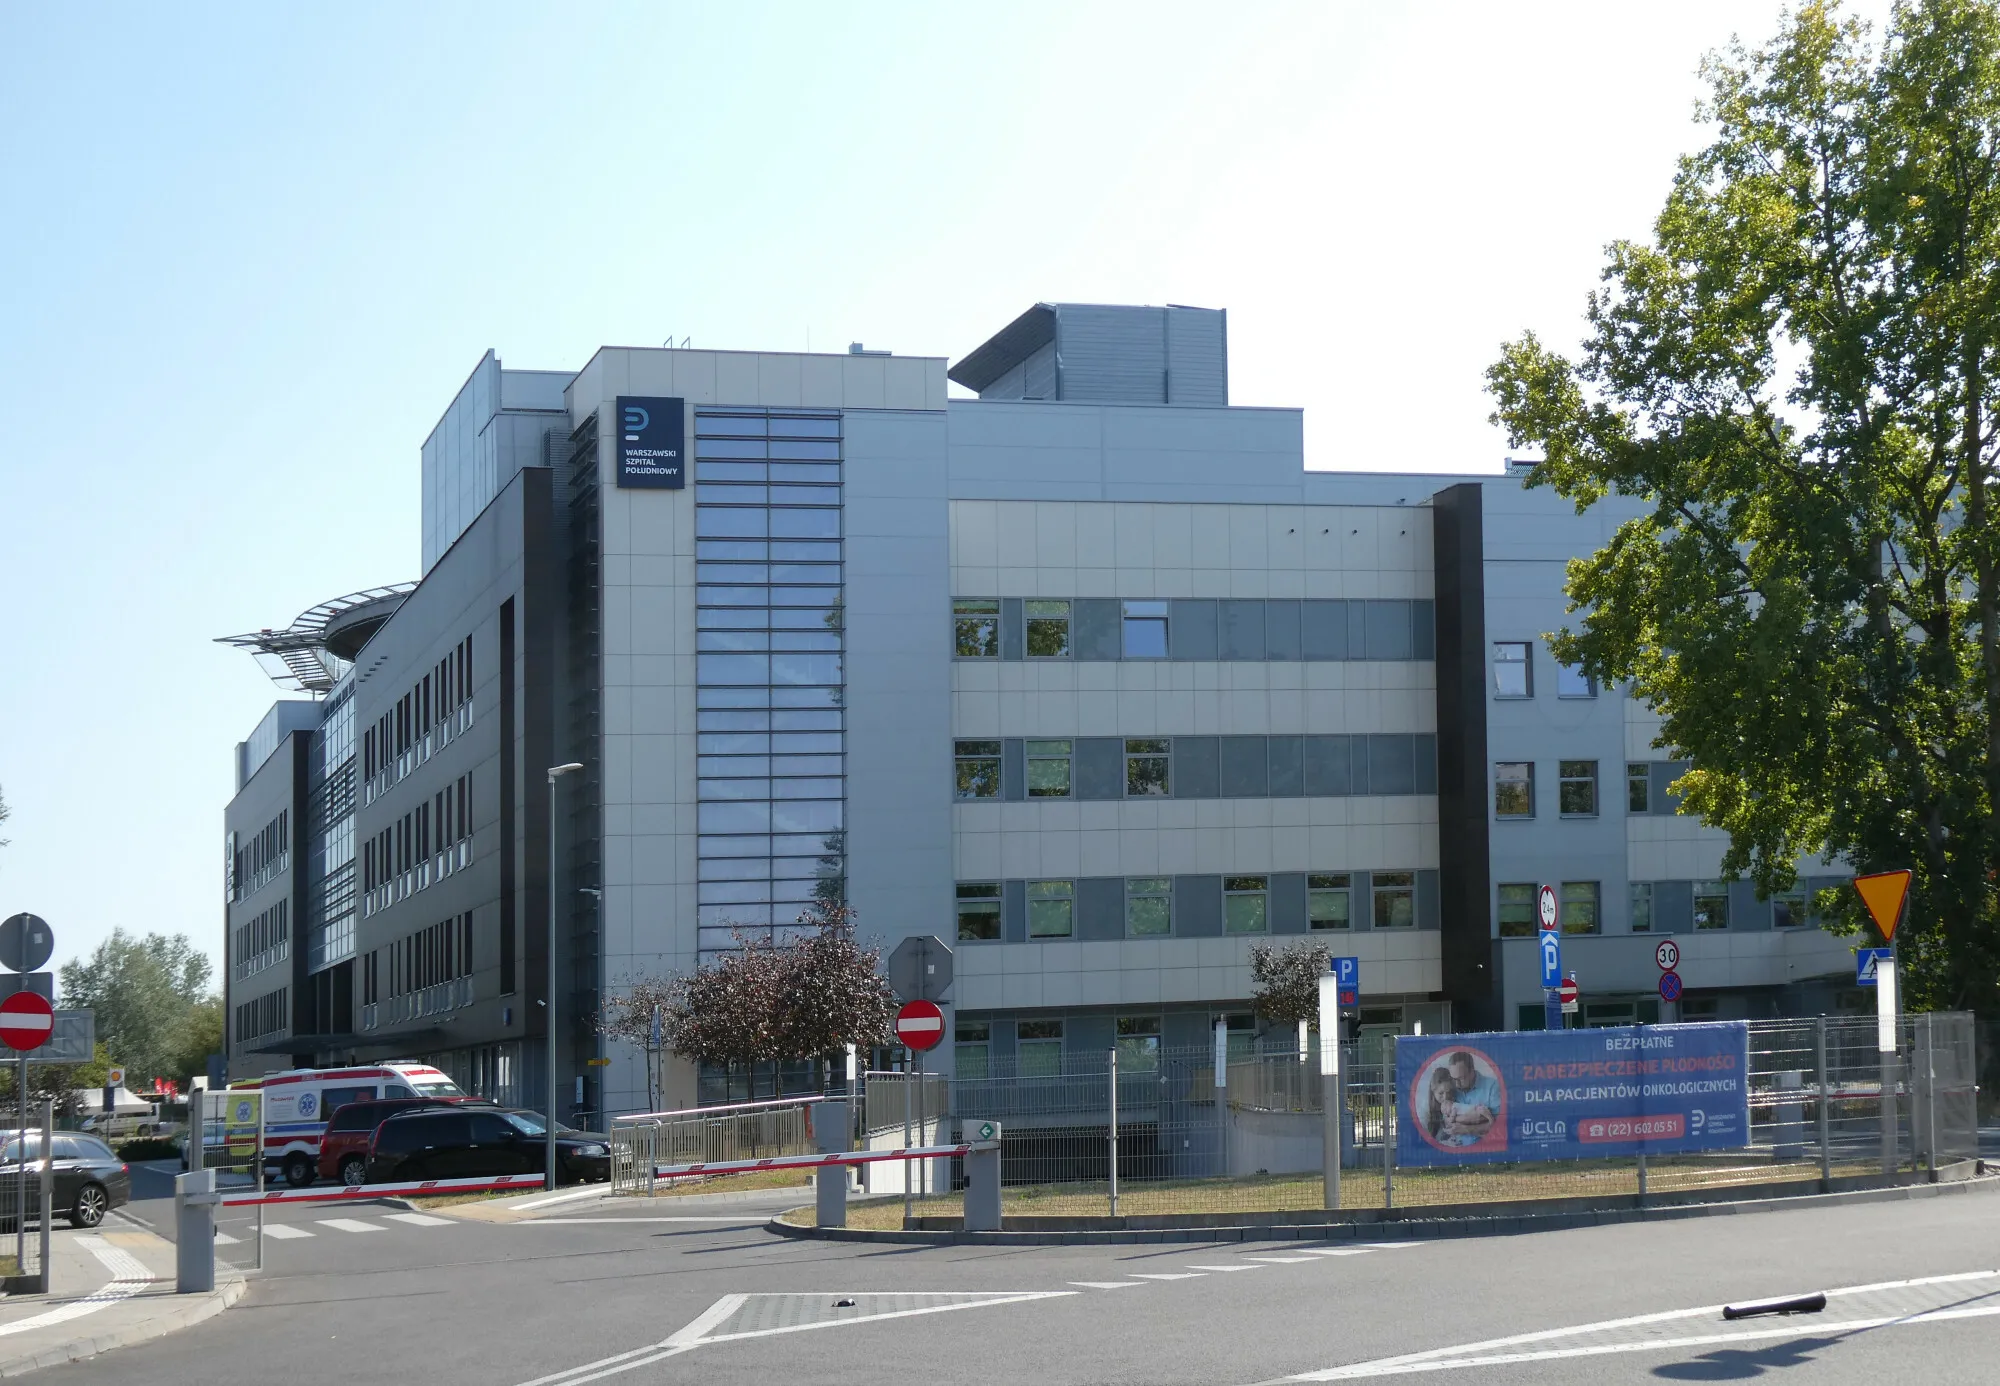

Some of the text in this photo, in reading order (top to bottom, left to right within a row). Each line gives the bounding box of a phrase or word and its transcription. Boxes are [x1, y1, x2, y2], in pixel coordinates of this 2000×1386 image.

[625, 449, 676, 457] WARSZAWSKI
[625, 458, 656, 466] SZPITAL
[625, 467, 678, 475] POŁUDNIOWY
[1545, 945, 1557, 979] P
[1659, 948, 1676, 963] 30
[1341, 959, 1353, 981] P
[1605, 1035, 1674, 1051] BEZPŁATNE
[1523, 1059, 1660, 1081] ZABEZPIECZENIE
[1525, 1079, 1737, 1103] DLA PACJENTÓW ONKOLOGICZNYCH
[1607, 1119, 1677, 1137] (22) 602 05 51
